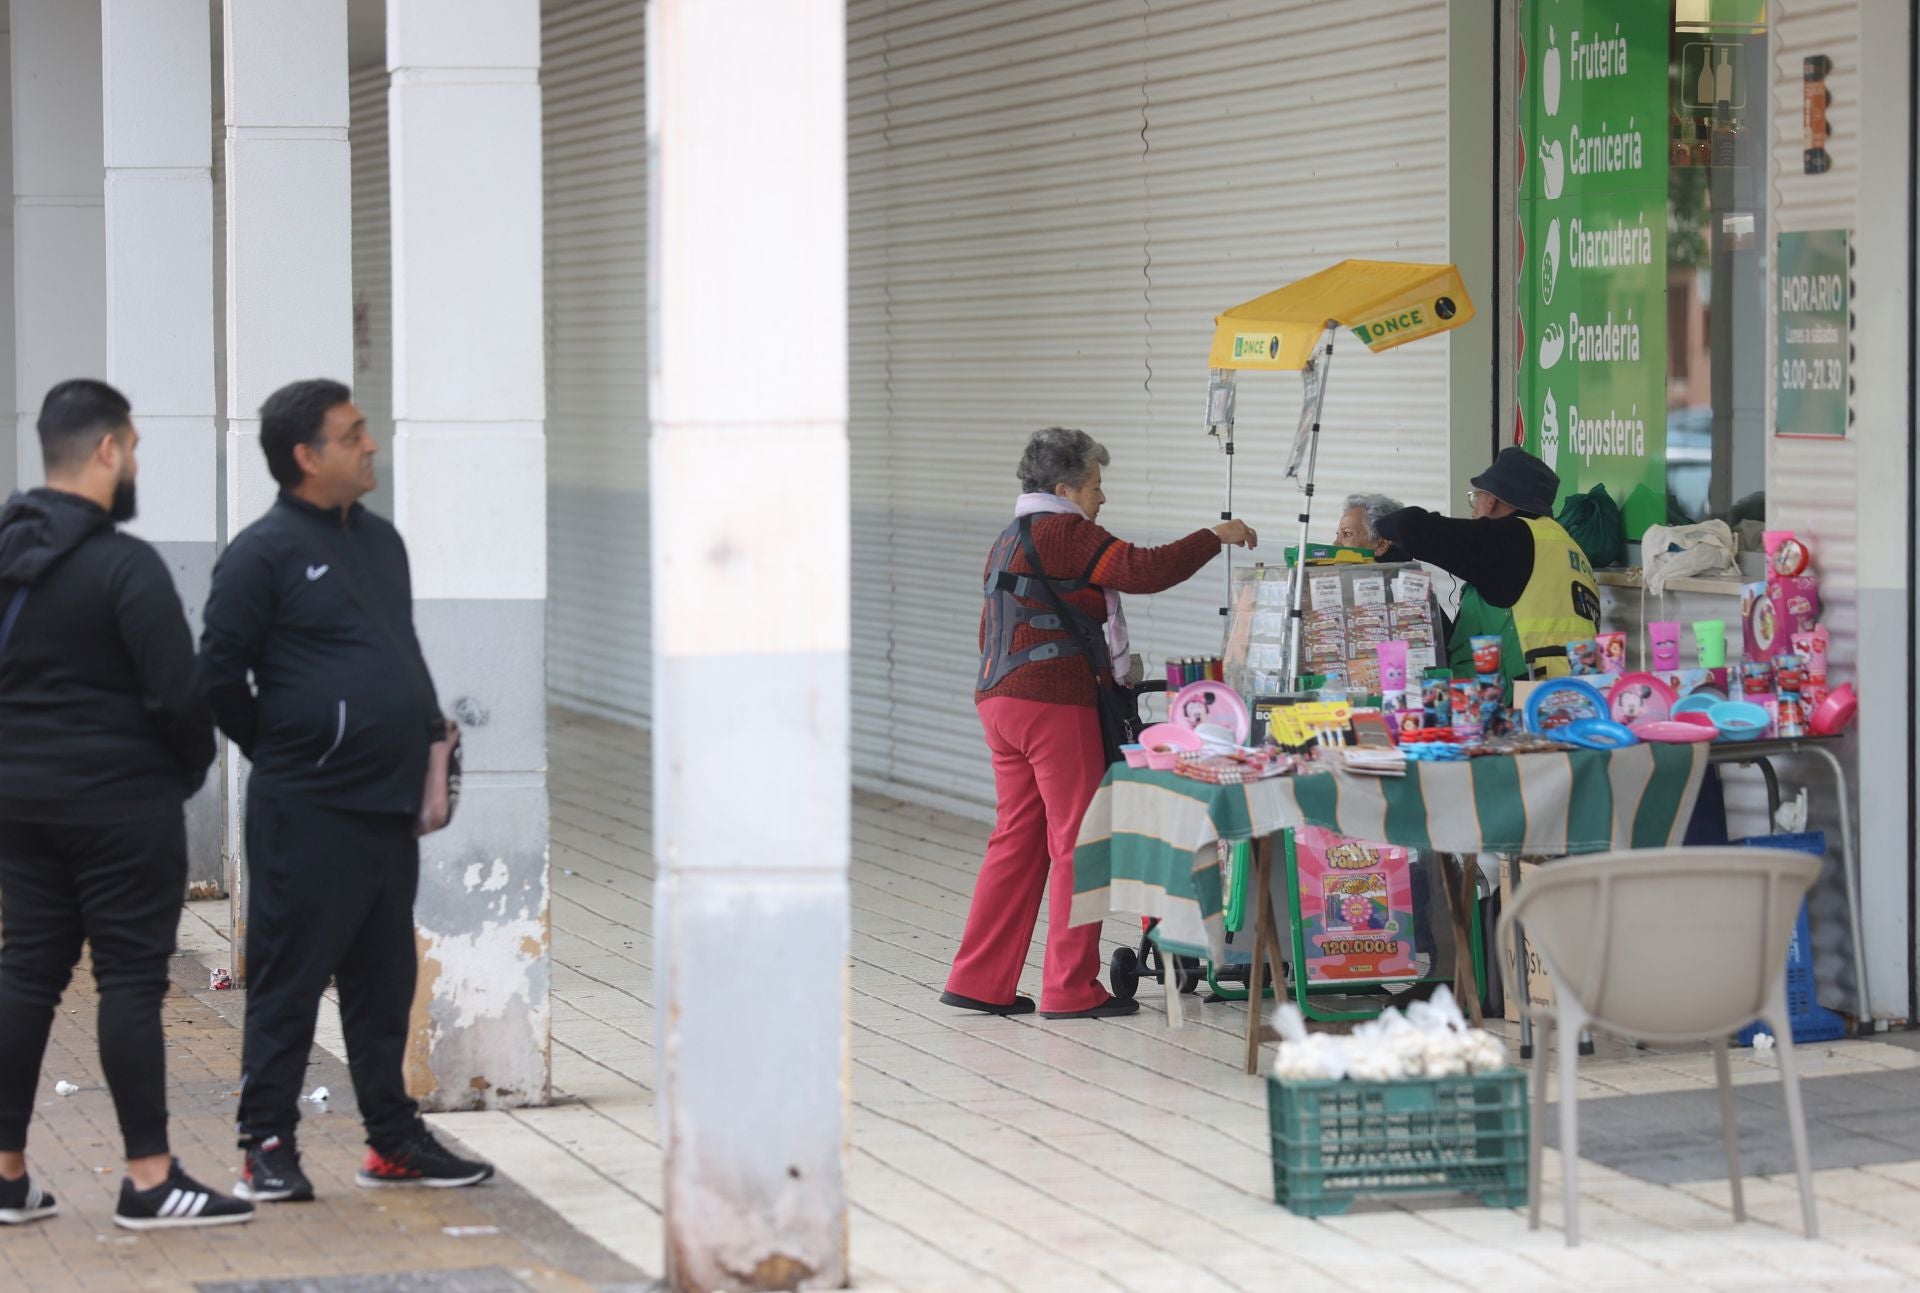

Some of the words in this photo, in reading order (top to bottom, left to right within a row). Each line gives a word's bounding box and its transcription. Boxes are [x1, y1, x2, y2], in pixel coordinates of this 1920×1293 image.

[1570, 22, 1627, 81] Frutería
[1569, 115, 1642, 175] Carnicería
[1569, 211, 1651, 268] Charcutería
[1781, 274, 1842, 312] HORARIO
[1242, 339, 1265, 355] ONCE
[1371, 310, 1424, 337] ONCE
[1569, 308, 1640, 362] Panadería
[1568, 404, 1645, 467] Repostería
